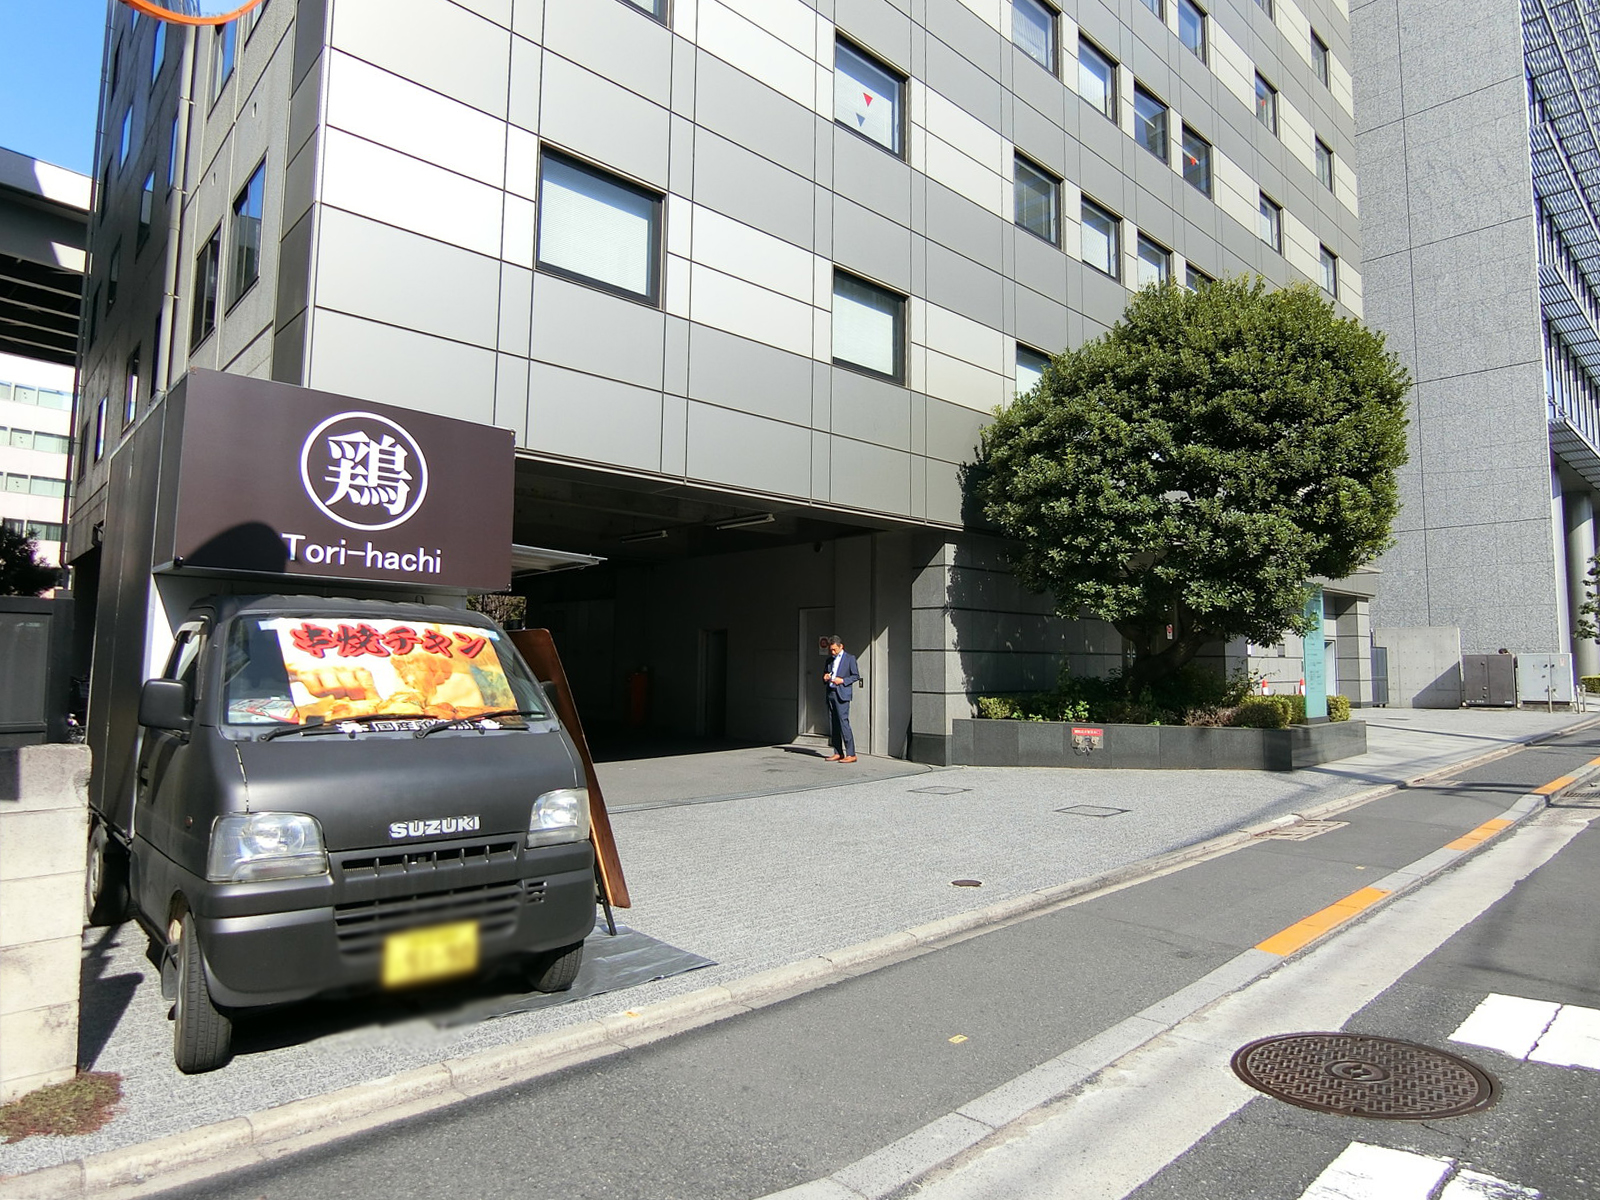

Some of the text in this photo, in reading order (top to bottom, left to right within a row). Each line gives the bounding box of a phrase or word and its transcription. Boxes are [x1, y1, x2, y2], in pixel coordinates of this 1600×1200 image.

[324, 430, 413, 517] 鶏
[281, 532, 443, 575] Tori-hachi
[389, 815, 480, 839] SUZUKI
